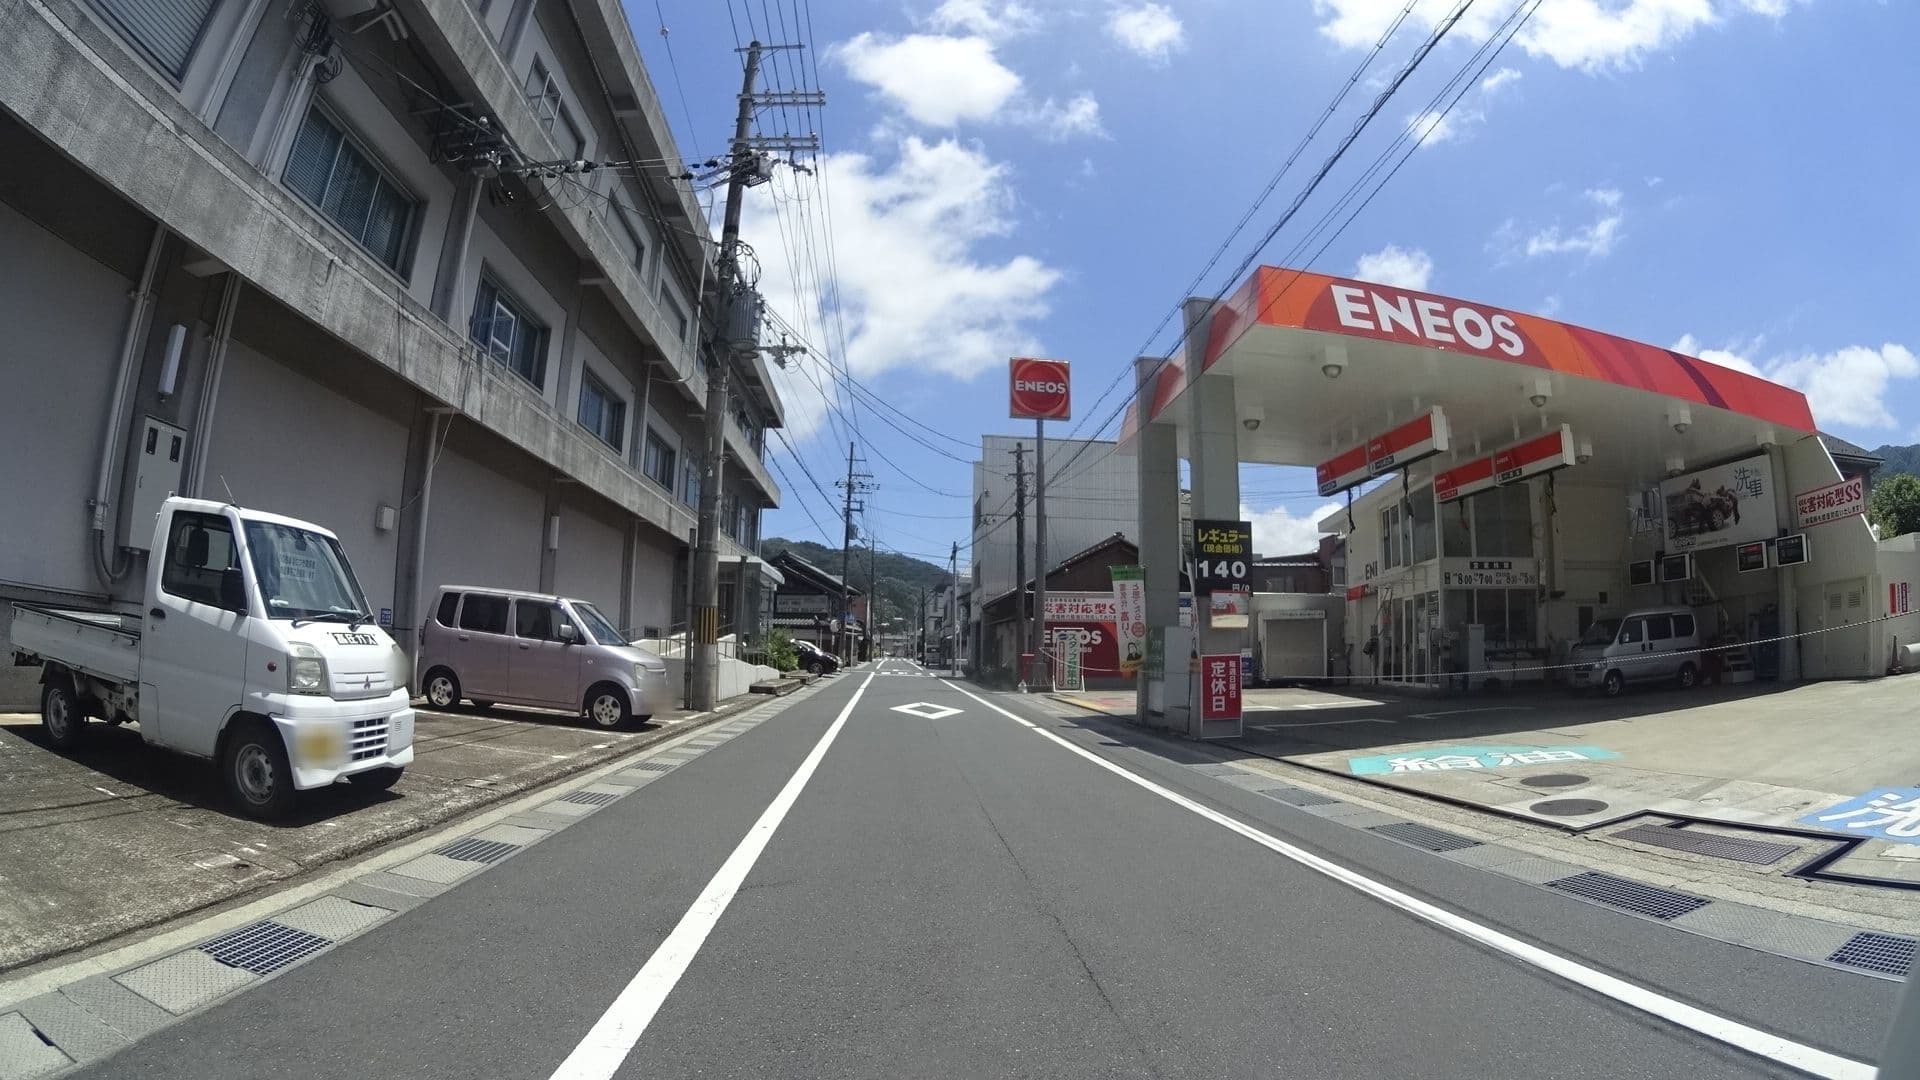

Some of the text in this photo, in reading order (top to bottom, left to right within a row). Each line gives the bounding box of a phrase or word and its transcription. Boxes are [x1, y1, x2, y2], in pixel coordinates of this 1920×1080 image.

[1330, 284, 1525, 357] ENEOS
[1015, 380, 1066, 394] ENEOS
[1734, 467, 1764, 499] 洗車
[1798, 482, 1861, 515] 災害対応型SS
[1198, 528, 1249, 543] レギュラー
[1199, 560, 1246, 578] 140
[1211, 662, 1227, 712] 定休日
[1388, 751, 1590, 772] 給油
